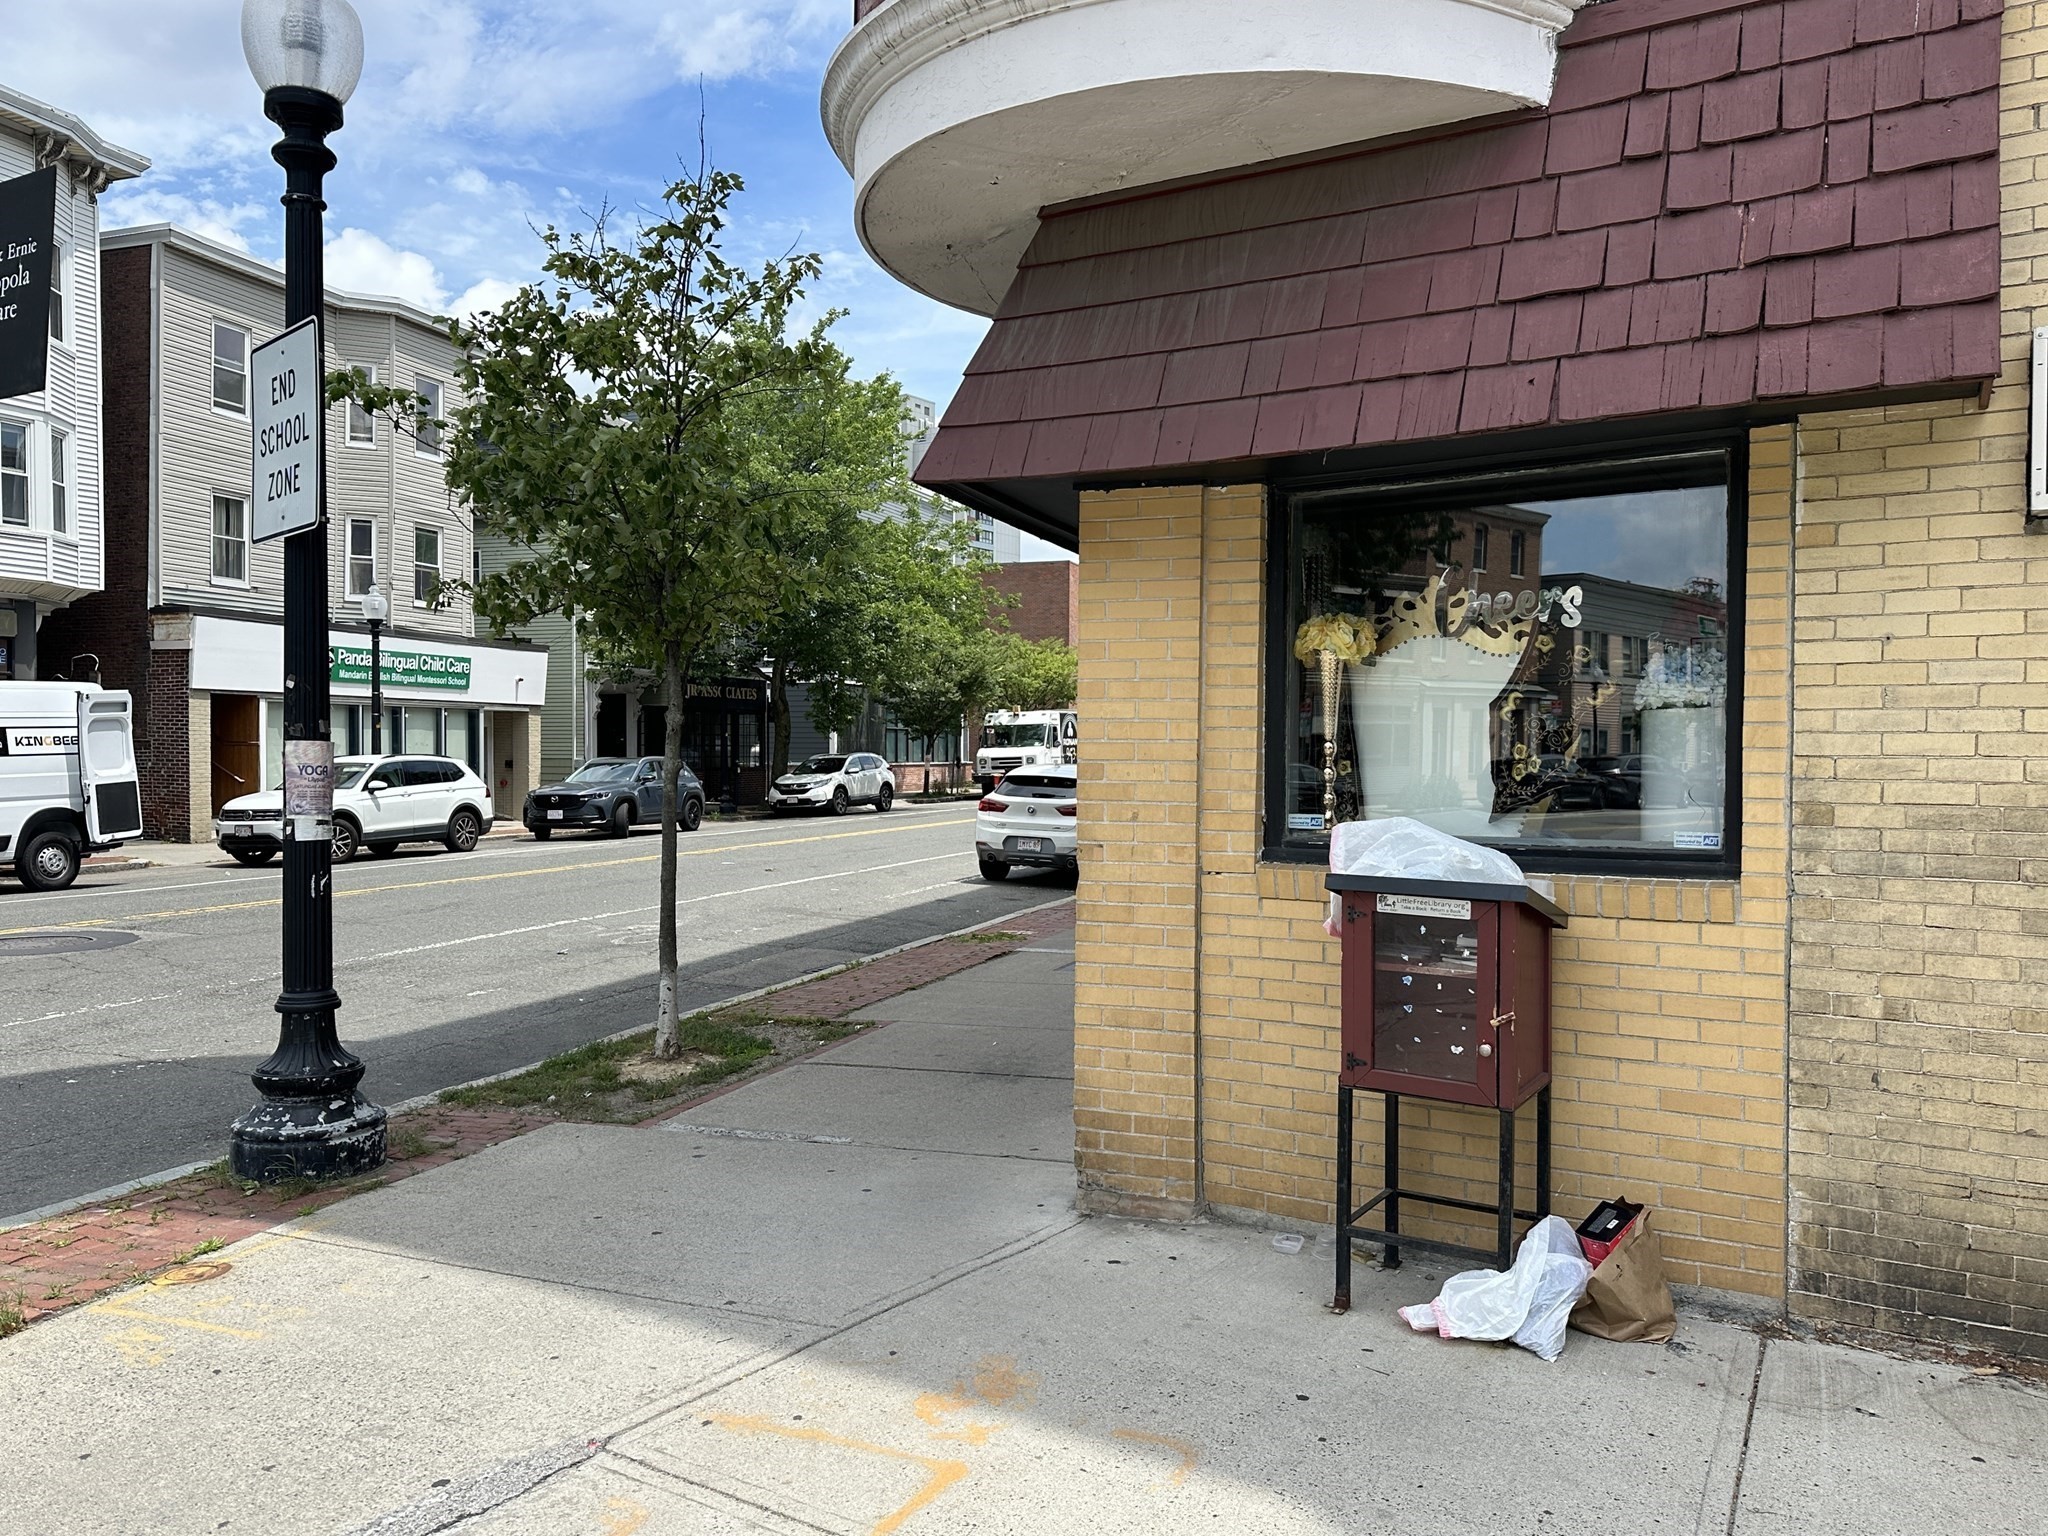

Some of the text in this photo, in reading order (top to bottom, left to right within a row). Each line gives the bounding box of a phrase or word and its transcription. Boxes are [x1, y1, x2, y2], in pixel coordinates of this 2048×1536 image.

[7, 237, 38, 260] Ernie
[0, 264, 30, 297] pola
[271, 368, 296, 406] END
[260, 412, 310, 458] SCHOOL
[267, 463, 301, 502] ZONE
[1435, 565, 1583, 640] Cheers
[338, 648, 372, 667] Panda
[420, 655, 446, 672] Child
[446, 657, 470, 674] Care
[339, 669, 467, 686] Mandarin Elish Bilingual Montessori School
[14, 735, 79, 747] KINGBEE
[297, 765, 329, 776] YOGA
[1311, 818, 1322, 826] ADT
[1703, 836, 1719, 845] ADT
[1396, 897, 1466, 911] LittleFreeLibraryorg
